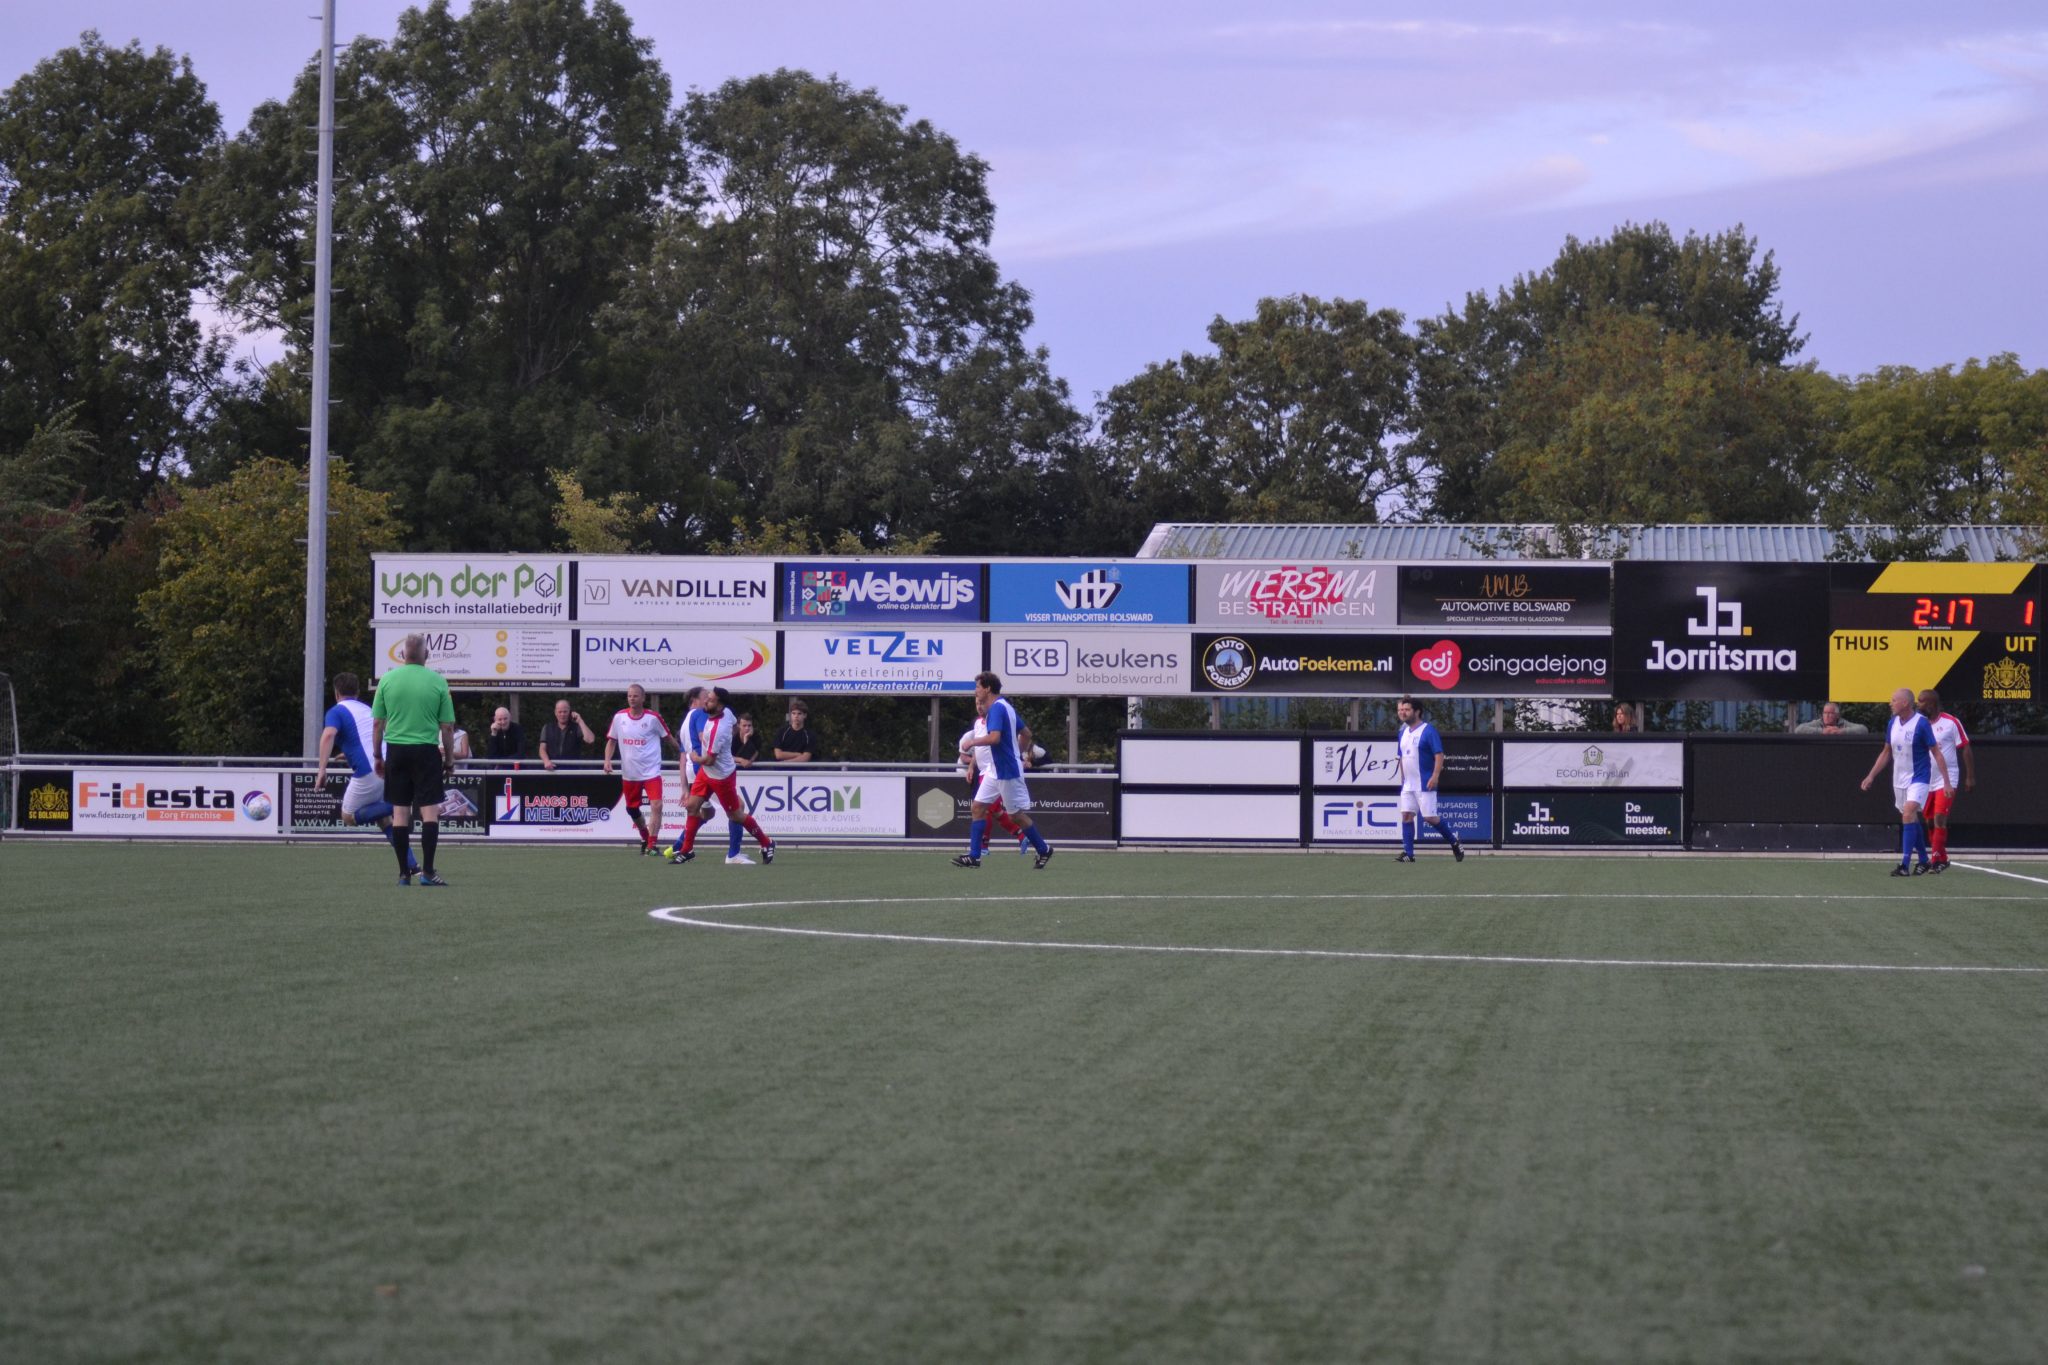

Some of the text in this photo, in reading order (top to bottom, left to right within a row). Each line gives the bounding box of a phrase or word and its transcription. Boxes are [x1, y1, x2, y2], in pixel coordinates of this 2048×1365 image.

[451, 563, 507, 598] der
[1218, 569, 1377, 600] WIERSMA
[840, 571, 974, 610] Webwijs
[381, 602, 562, 616] Technisch installatiebedrijf
[1218, 601, 1375, 616] BESTRATINGEN
[1441, 602, 1571, 612] AUTOMOTIVE BOLSWARD
[1913, 599, 1974, 625] 2:17
[1025, 613, 1153, 622] VISSER TRANSPORTEN BOLSWARD
[586, 637, 672, 652] DINKLA
[824, 631, 943, 662] VELZEN
[1214, 639, 1245, 651] AUTO
[1833, 636, 1889, 651] THUIS
[1917, 637, 1953, 651] MIN
[2005, 636, 2036, 652] UIT
[609, 656, 743, 668] verkeersopleidingen
[1014, 648, 1059, 667] BKB
[1076, 648, 1178, 668] keukens
[1646, 640, 1797, 671] Jorritsma
[1259, 656, 1393, 672] AutoFoekema.nl
[1419, 650, 1453, 677] odj
[1468, 654, 1606, 676] osingadejong
[824, 667, 944, 680] textielreiniging
[1076, 673, 1178, 684] bkbbolsward.nl
[1206, 665, 1252, 687] FOEKEMA
[822, 682, 943, 691] www.velzentextiel.nl
[1983, 690, 2031, 699] SC BOLSWARD
[79, 782, 235, 809] F-idesta
[525, 796, 588, 808] LANGS DE
[1041, 800, 1104, 809] Verduurzamen
[1625, 802, 1641, 813] De
[28, 811, 69, 820] SC BOLSWARD
[79, 811, 145, 821] www.fidestazorg.nl
[159, 811, 221, 821] Zorg Franchise
[525, 807, 610, 822] MELKWEG
[756, 814, 818, 822] ADMINISTRATIE
[1512, 823, 1570, 835] Jorritsma
[1625, 825, 1672, 835] meester.
